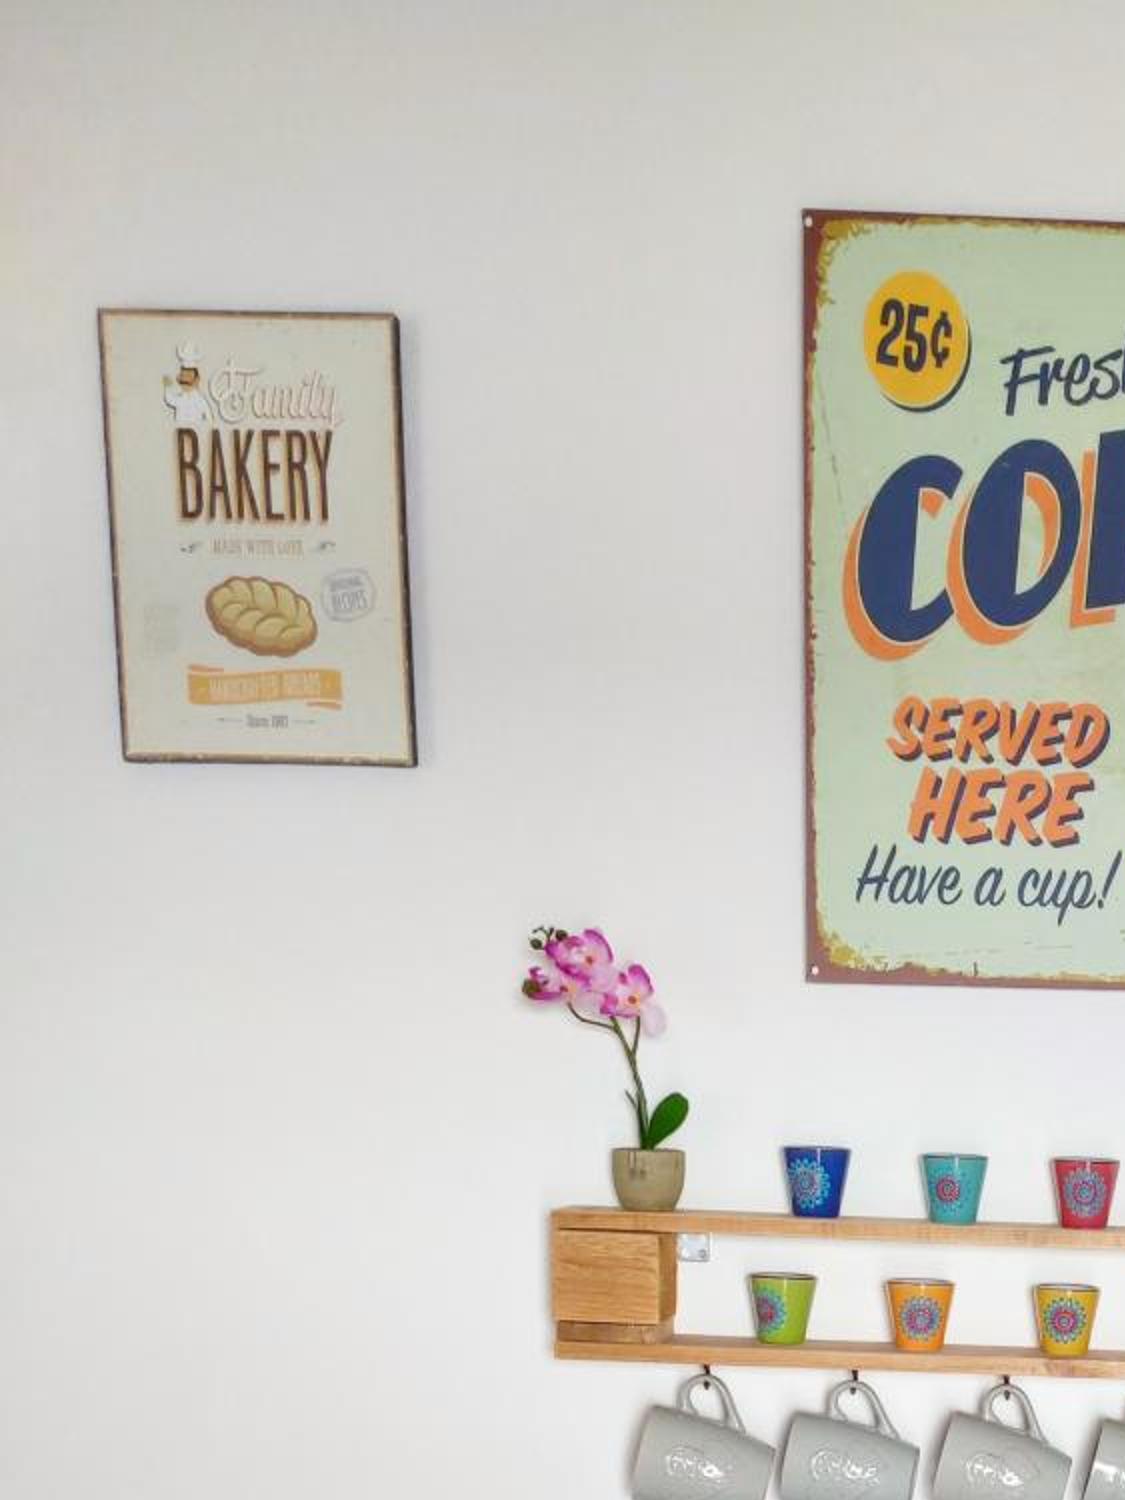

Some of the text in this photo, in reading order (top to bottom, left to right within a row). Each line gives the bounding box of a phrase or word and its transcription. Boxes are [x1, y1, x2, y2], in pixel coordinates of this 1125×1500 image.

[875, 298, 954, 372] 25¢
[208, 358, 344, 427] Family
[176, 429, 333, 522] BAKERY
[886, 694, 1111, 767] SERVED
[907, 767, 1097, 847] HERE
[856, 845, 1122, 926] Have a cup!
